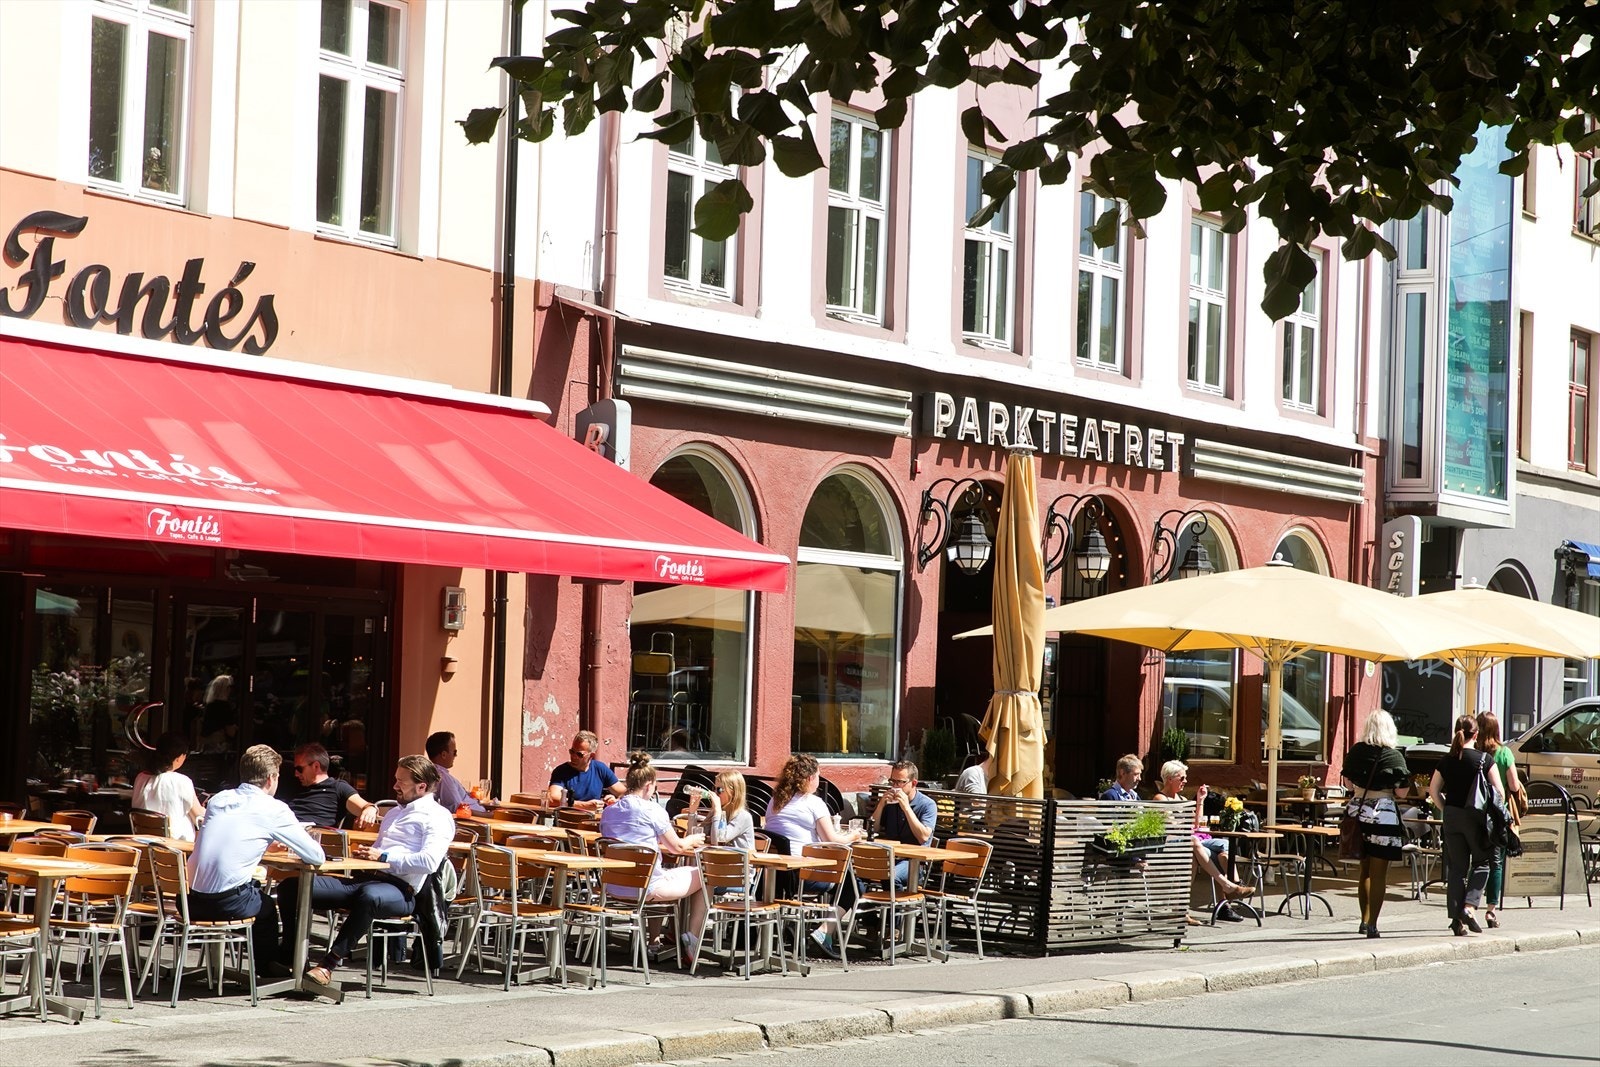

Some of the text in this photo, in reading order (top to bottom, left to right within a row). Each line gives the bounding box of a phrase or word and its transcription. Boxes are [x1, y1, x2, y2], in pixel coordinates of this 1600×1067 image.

[0, 210, 279, 356] Fontés
[932, 391, 1185, 473] PARKTEATRET
[148, 508, 221, 535] Fontés
[655, 555, 704, 577] Fontés
[1388, 530, 1406, 597] SCE
